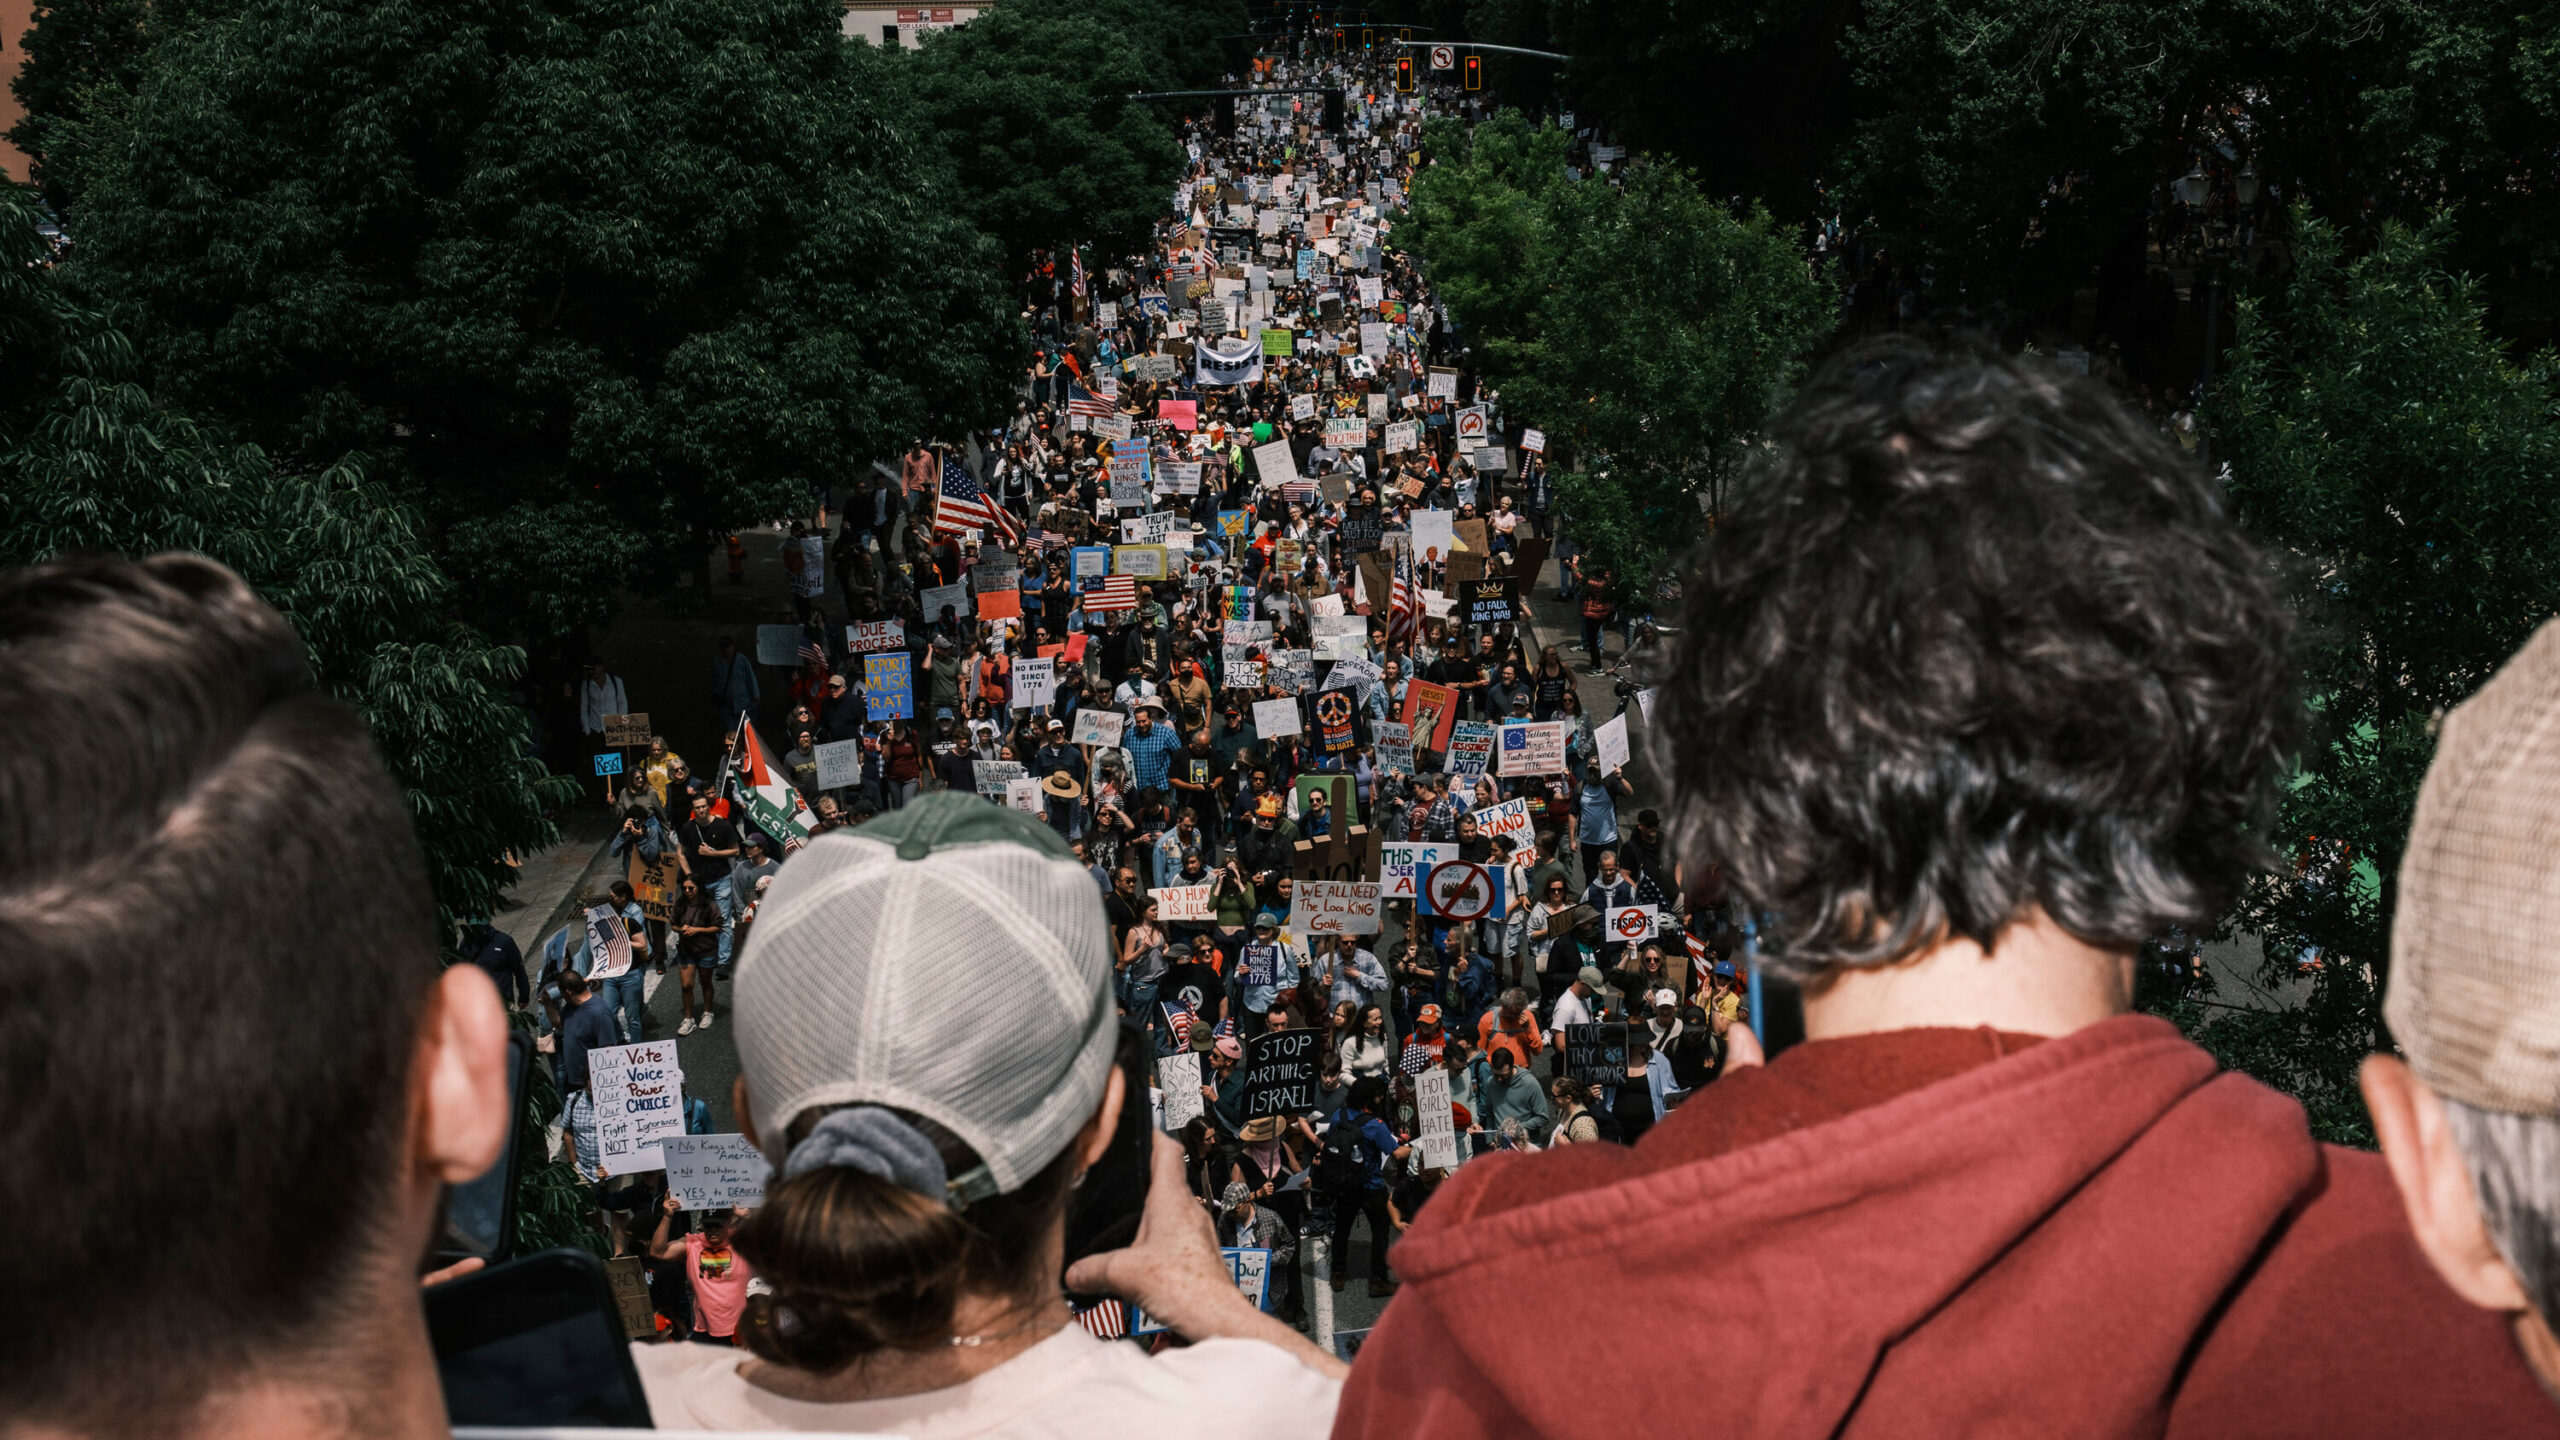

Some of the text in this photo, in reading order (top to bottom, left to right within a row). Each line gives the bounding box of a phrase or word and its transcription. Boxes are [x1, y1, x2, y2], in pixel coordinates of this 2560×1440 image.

[1201, 357, 1259, 370] RESIST
[1326, 419, 1364, 431] STRONGER
[1327, 433, 1364, 444] TOGETHER
[1145, 513, 1173, 525] TRUMP
[1149, 526, 1160, 534] IS
[1343, 528, 1379, 539] JUST TOO
[1190, 578, 1207, 586] RESIST
[1224, 605, 1250, 617] YASS
[1473, 600, 1508, 611] NO FAUX
[1471, 609, 1511, 622] KING WAY
[860, 622, 887, 637] DUE
[850, 635, 903, 653] PROCESS
[1292, 652, 1308, 660] NOT
[864, 656, 908, 674] DEPORT
[1230, 663, 1256, 674] STOP
[1225, 674, 1262, 686] FASCISM
[1273, 668, 1297, 681] STOP
[865, 673, 910, 691] MUSK
[1267, 675, 1298, 692] FASCISM
[1421, 689, 1445, 701] RESIST
[871, 695, 904, 709] RAT
[606, 725, 649, 734] ANTI-KING
[1323, 723, 1352, 734] NO KINGS
[1467, 722, 1489, 730] WHEN
[629, 733, 651, 743] 1776
[1332, 730, 1353, 738] FASCISTS
[1526, 731, 1551, 739] Telling
[1326, 740, 1355, 752] NO HATE
[1379, 736, 1410, 748] ANGRY
[1451, 742, 1489, 752] RESISTANCE
[820, 745, 851, 757] FACISM
[1454, 752, 1486, 761] BECOMES
[824, 755, 850, 766] NEVER
[1386, 756, 1411, 765] PAYING
[1524, 762, 1541, 771] 1776
[827, 766, 849, 774] ENDS
[978, 763, 1018, 774] NO ONES
[1452, 761, 1486, 775] DUTY
[827, 775, 851, 784] WELL
[986, 774, 1013, 782] ILLEGAL
[978, 783, 987, 792] ON
[1477, 799, 1524, 824] IF YOU
[1478, 815, 1524, 836] STAND
[1381, 848, 1438, 865] THIS IS
[645, 866, 664, 877] IS
[642, 875, 665, 887] FOR
[635, 883, 674, 903] PRIDE
[1160, 890, 1181, 902] NO
[1300, 885, 1379, 899] WE ALL NEED
[1169, 903, 1181, 915] IS
[1300, 899, 1318, 912] The
[1324, 899, 1344, 912] Loco
[1612, 916, 1653, 930] FASCISTS
[1260, 947, 1272, 957] NO
[1249, 957, 1272, 965] KINGS
[1249, 965, 1271, 974] SINCE
[1248, 973, 1271, 984] 1776
[1569, 1026, 1605, 1043] LOVE
[1258, 1035, 1312, 1061] STOP
[595, 1049, 663, 1068] Our Vote
[1569, 1047, 1594, 1064] THY
[596, 1068, 664, 1087] Our Voice
[1245, 1063, 1313, 1087] ARMING
[1571, 1067, 1626, 1085] NEIGHBOR
[1421, 1076, 1445, 1095] HOT
[598, 1083, 665, 1102] Our Power
[1250, 1085, 1313, 1115] ISRAEL
[1419, 1095, 1449, 1113] GIRLS
[599, 1096, 670, 1117] Our CHOICE
[602, 1117, 678, 1140] Fight Ignorance
[1421, 1115, 1451, 1134] HATE
[605, 1139, 627, 1153] NOT
[678, 1141, 695, 1152] No
[701, 1140, 725, 1154] Kings
[1423, 1135, 1454, 1155] TRUMP
[719, 1152, 760, 1160] America
[681, 1167, 693, 1175] No
[704, 1167, 737, 1175] Dictators
[683, 1187, 722, 1198] YES to
